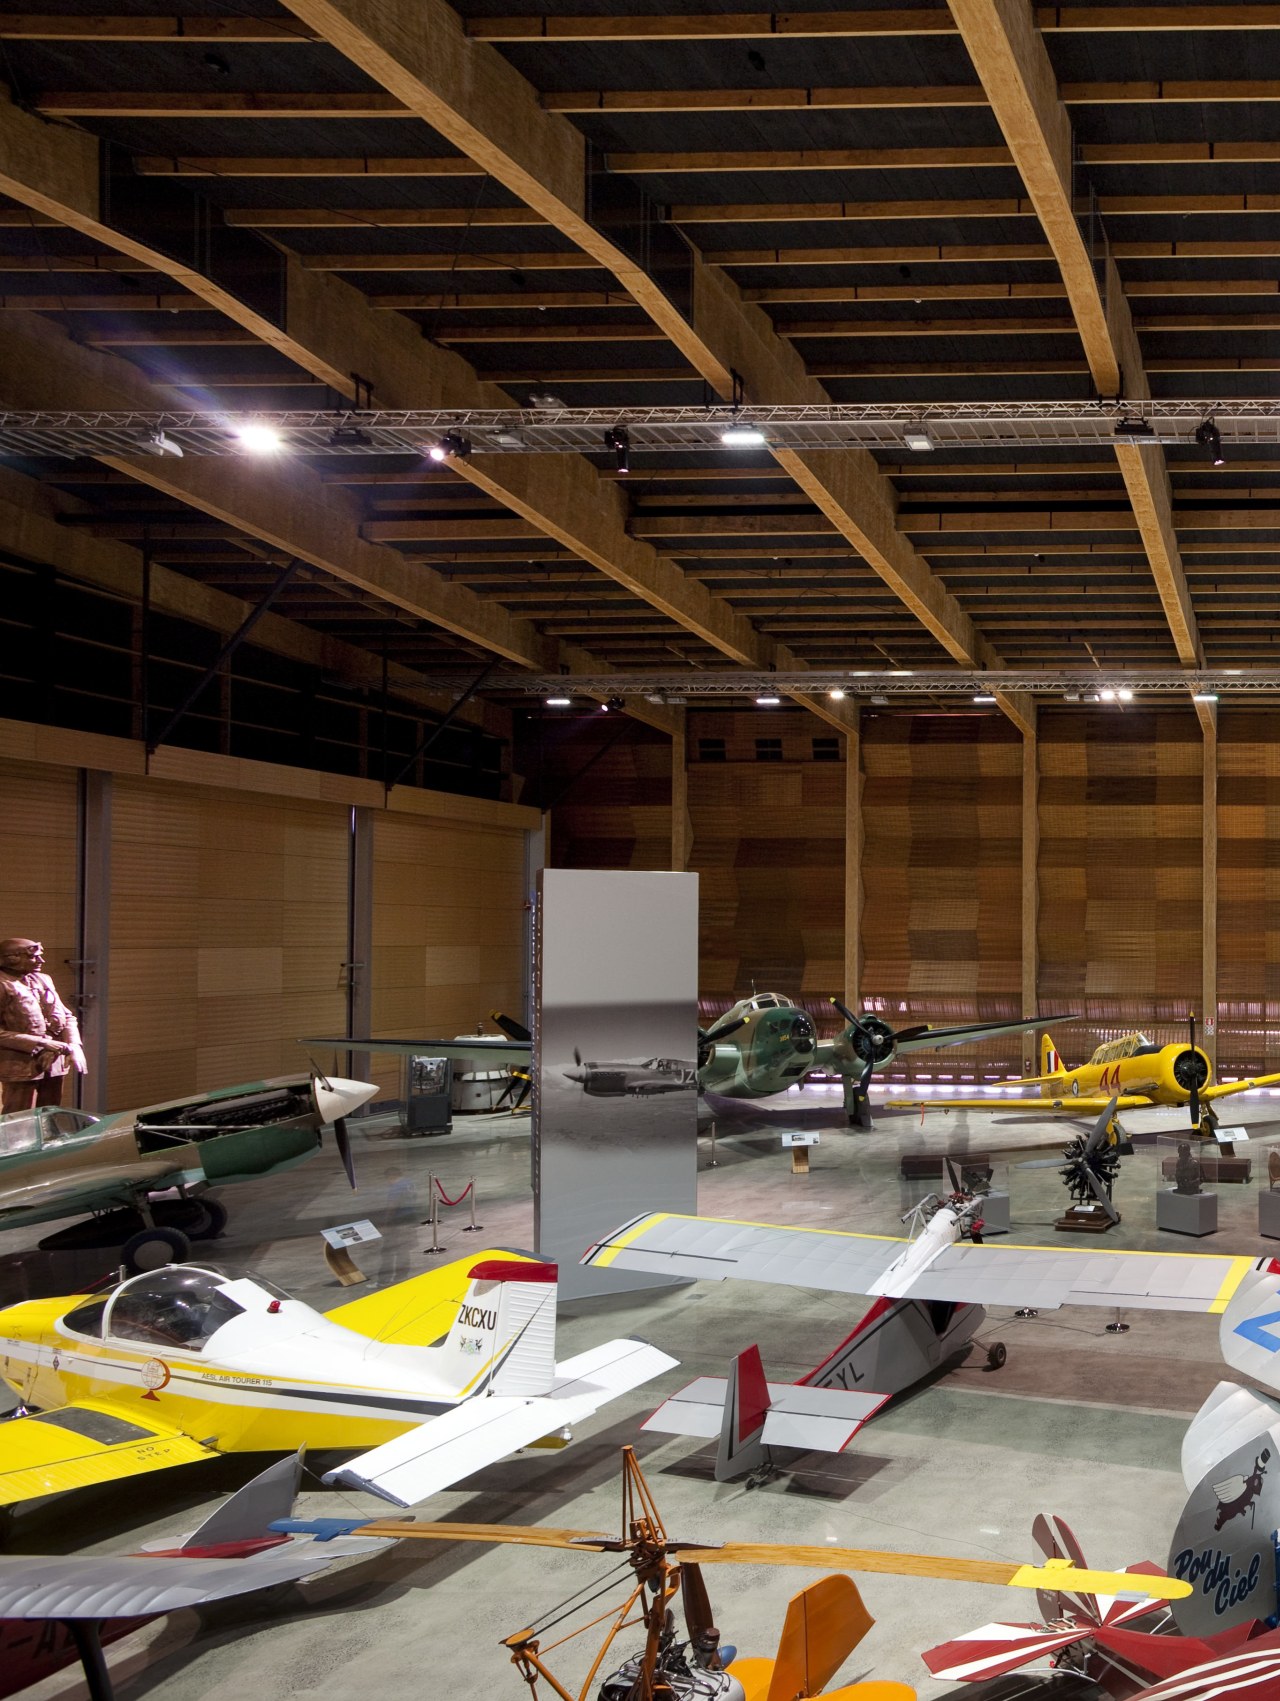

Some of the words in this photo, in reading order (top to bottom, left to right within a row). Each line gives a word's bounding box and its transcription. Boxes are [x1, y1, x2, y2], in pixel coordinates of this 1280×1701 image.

[674, 1069, 698, 1084] JZ
[1100, 1064, 1121, 1095] 44
[458, 1304, 497, 1330] ZKCXU
[201, 1373, 217, 1381] AESL
[232, 1376, 261, 1386] TOURER
[823, 1362, 865, 1390] YL
[136, 1446, 155, 1454] NO
[137, 1448, 171, 1461] STEP
[1174, 1548, 1213, 1583] Pou
[1202, 1550, 1231, 1595] du
[1214, 1552, 1261, 1616] Ciel
